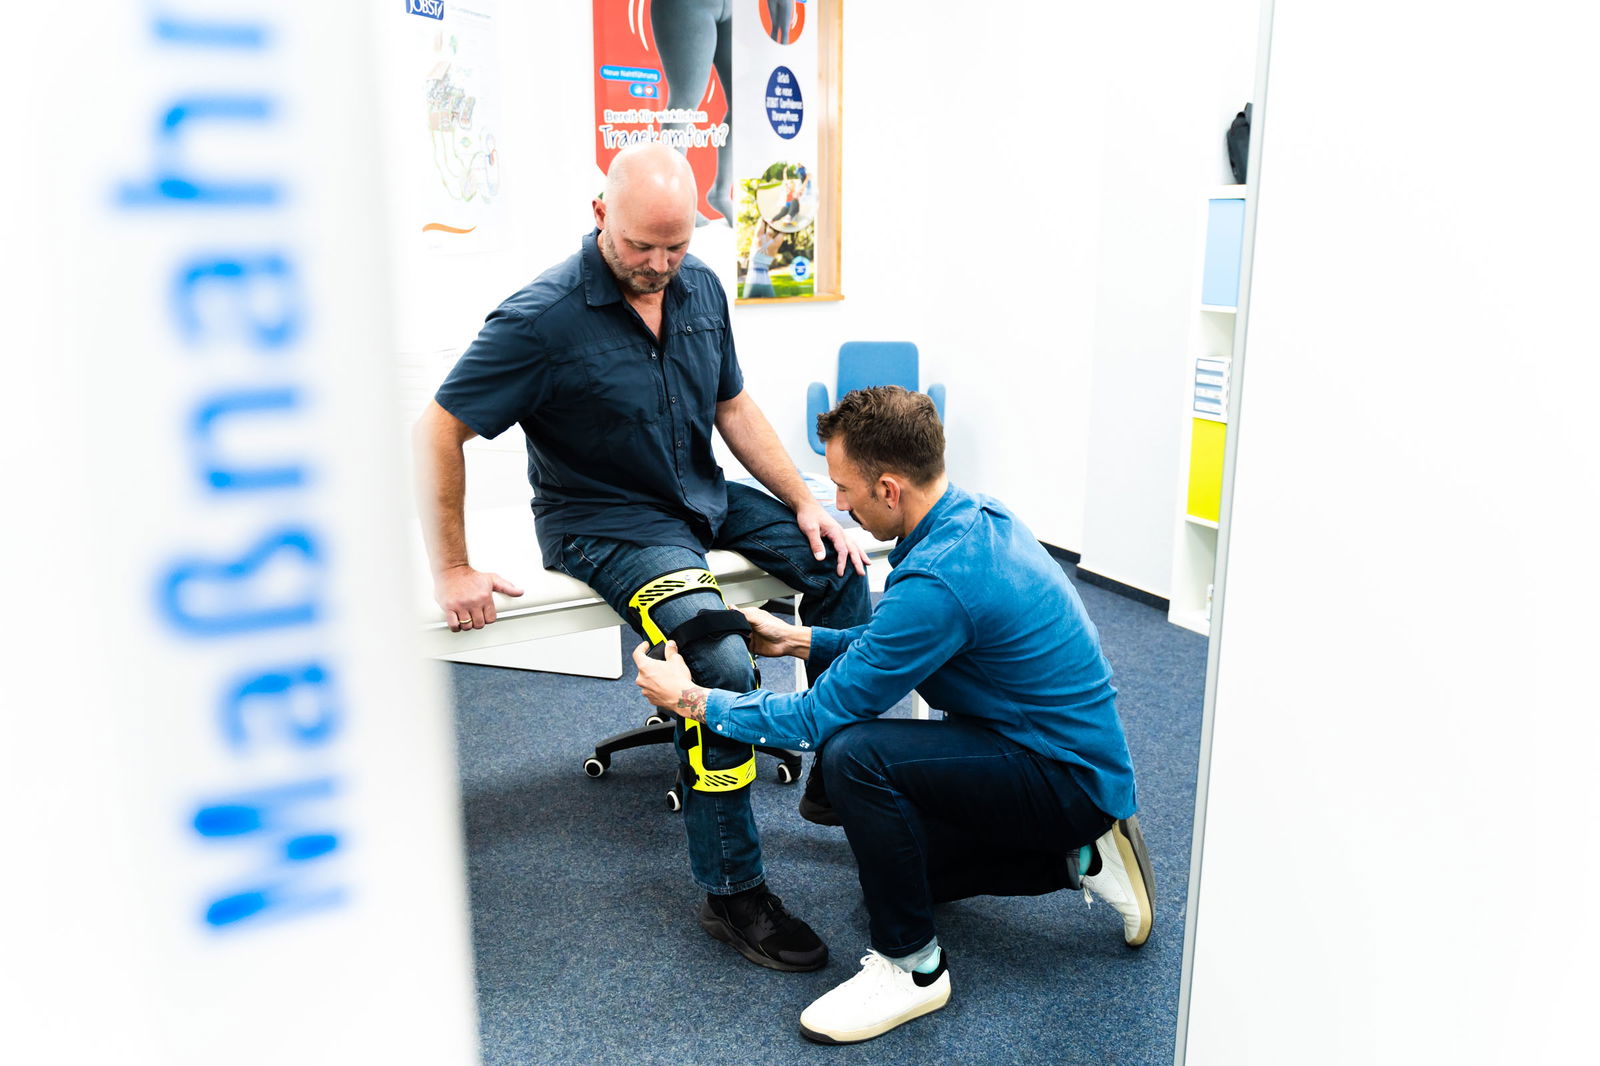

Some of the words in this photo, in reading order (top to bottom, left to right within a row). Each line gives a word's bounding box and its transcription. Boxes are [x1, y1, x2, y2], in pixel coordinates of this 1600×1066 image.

[605, 111, 637, 122] Bereit
[639, 110, 655, 122] für
[657, 110, 706, 122] wirklichen
